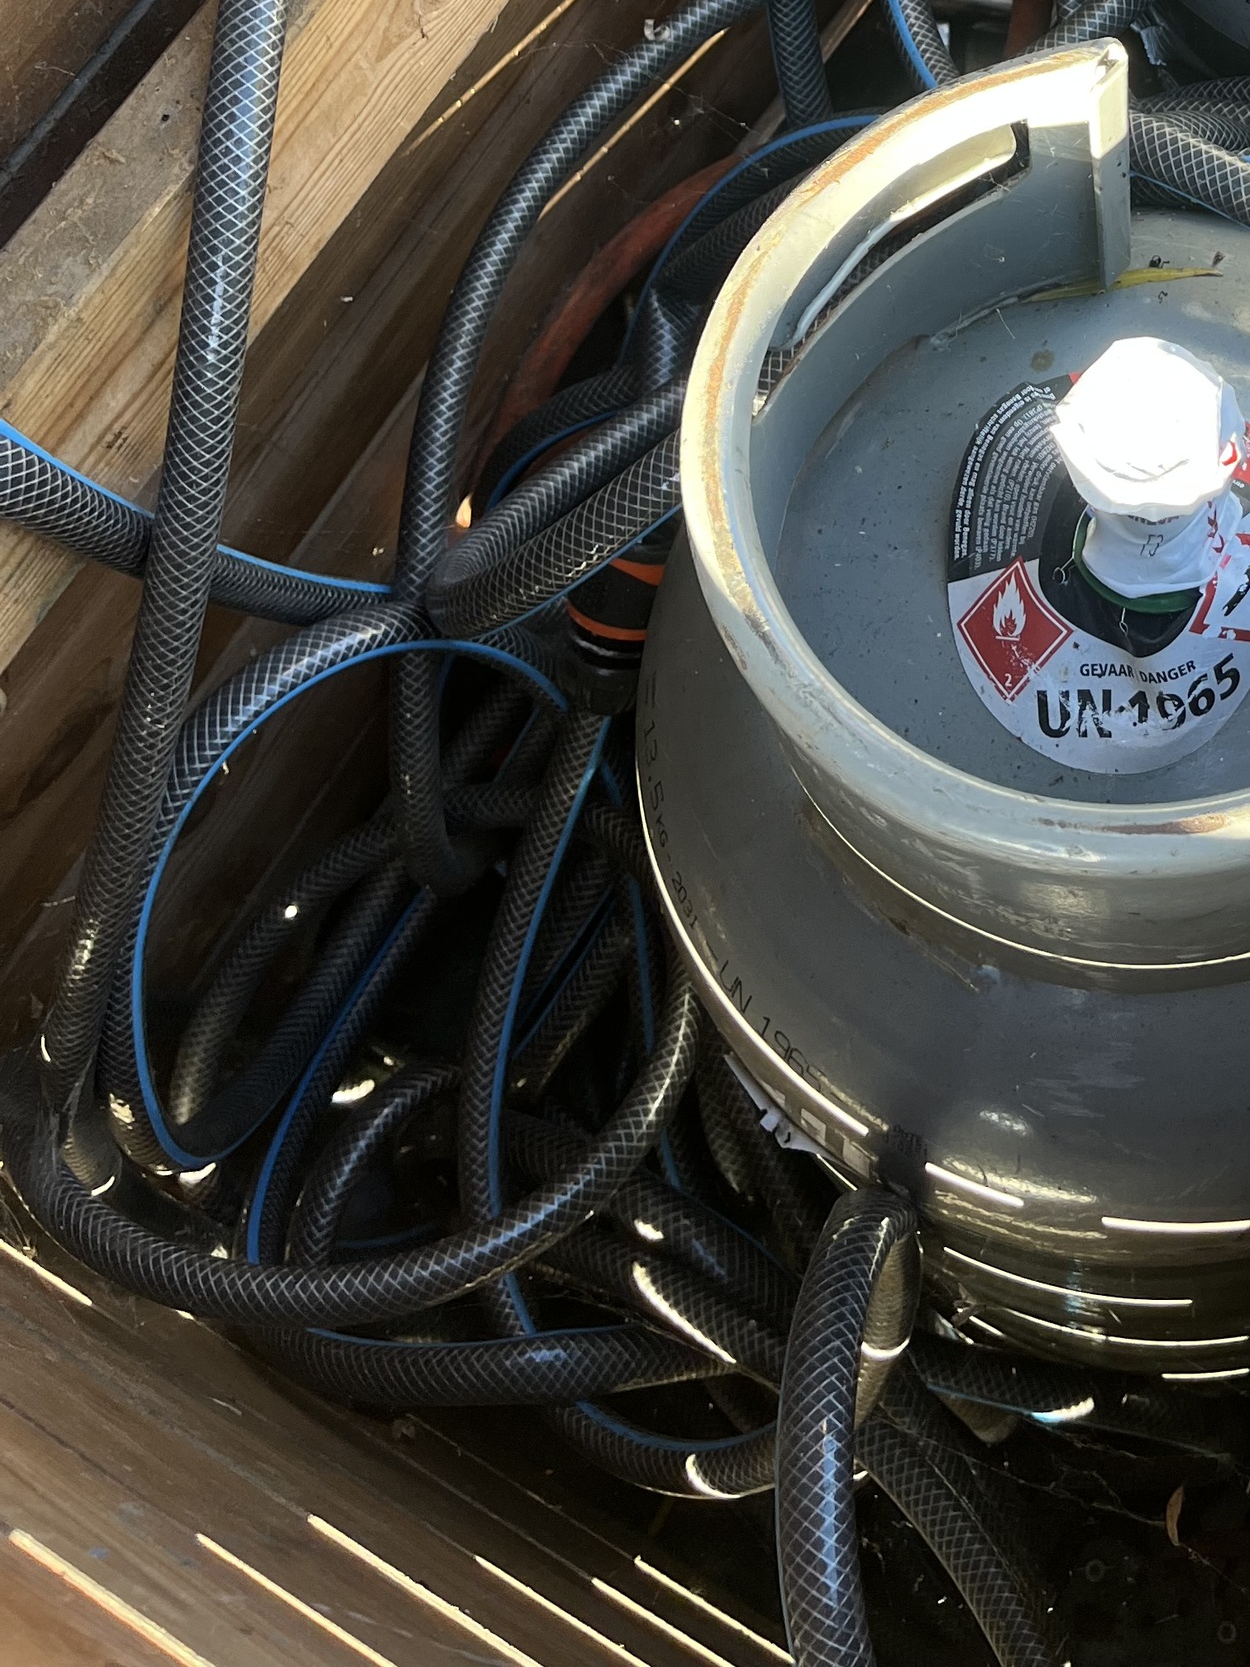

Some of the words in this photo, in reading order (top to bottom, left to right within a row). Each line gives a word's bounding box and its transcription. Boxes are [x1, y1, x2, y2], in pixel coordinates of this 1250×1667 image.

[990, 424, 1001, 435] van
[976, 434, 994, 462] Benegas
[975, 462, 982, 471] en
[968, 472, 978, 487] mag
[965, 488, 975, 509] alleen
[963, 510, 971, 525] door
[1003, 672, 1014, 689] 2
[1079, 660, 1134, 679] GEVAAR
[1138, 659, 1198, 684] DANGER
[1036, 689, 1114, 739] UN
[1127, 654, 1241, 733] 1965
[670, 870, 699, 931] 2031
[719, 958, 753, 1014] UN
[760, 1015, 827, 1092] 1965
